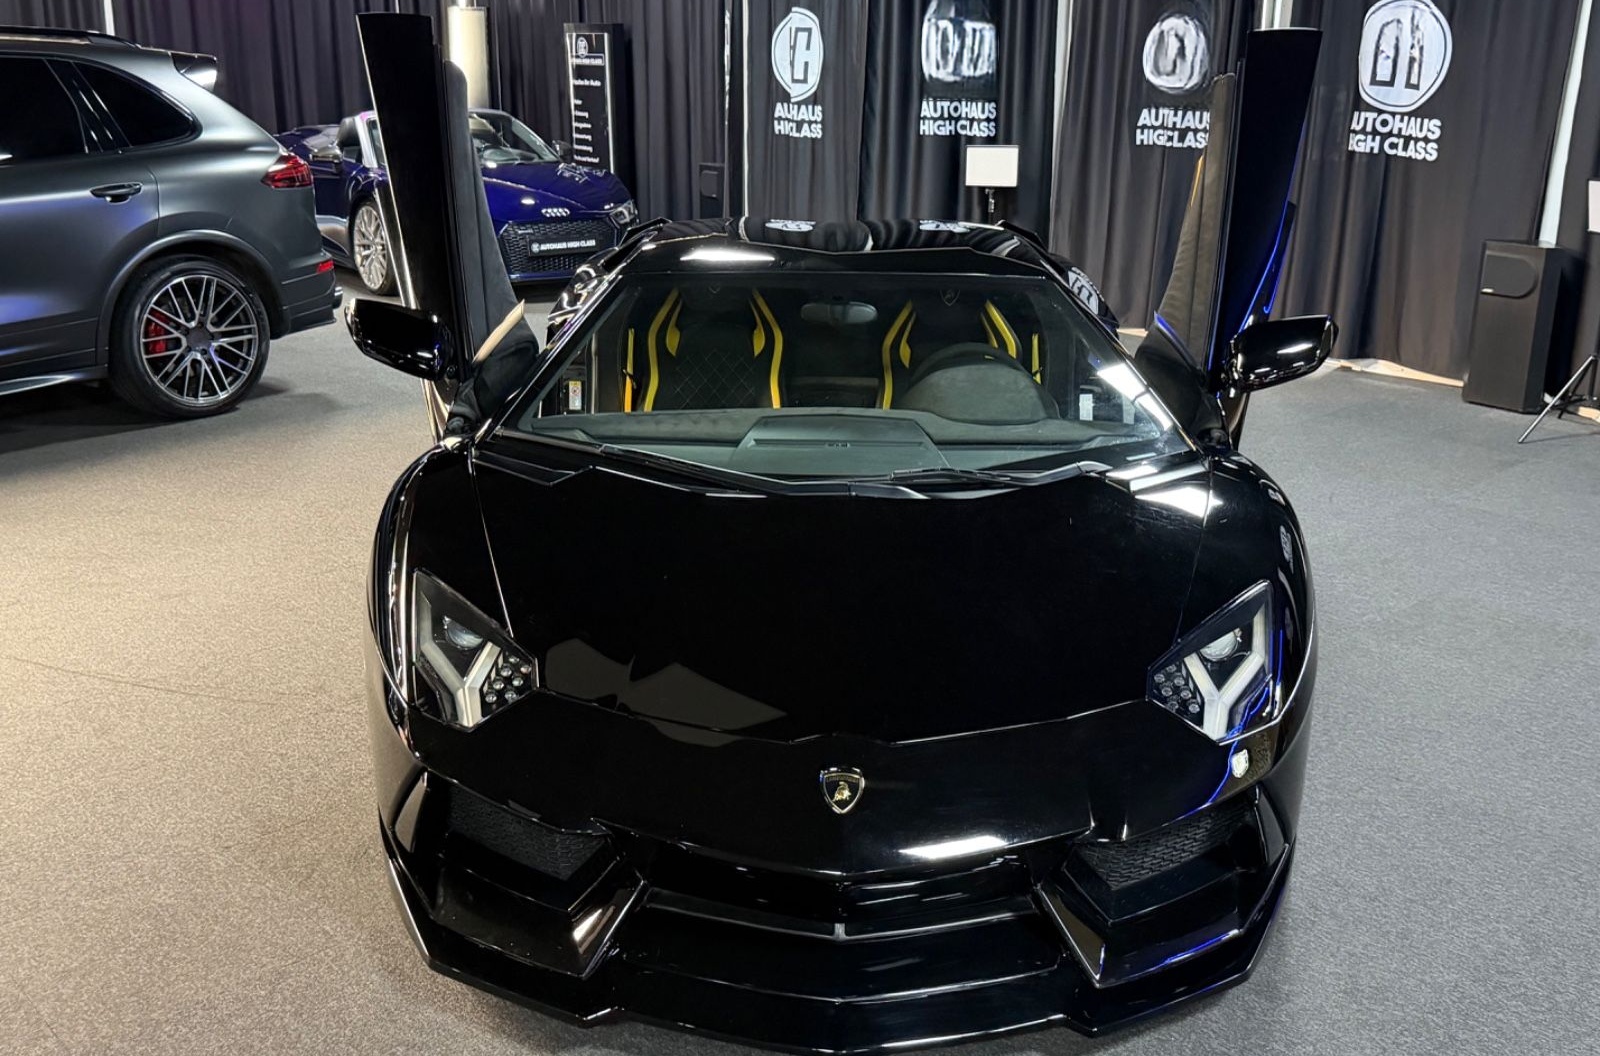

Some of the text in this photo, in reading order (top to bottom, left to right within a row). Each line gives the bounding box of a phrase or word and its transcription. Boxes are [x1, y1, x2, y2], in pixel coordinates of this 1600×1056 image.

[920, 99, 997, 119] AUTOHAUS
[919, 120, 996, 137] HIGH CLASS
[1350, 111, 1442, 140] UTOHAUS
[1348, 133, 1438, 162] IGH CLASS
